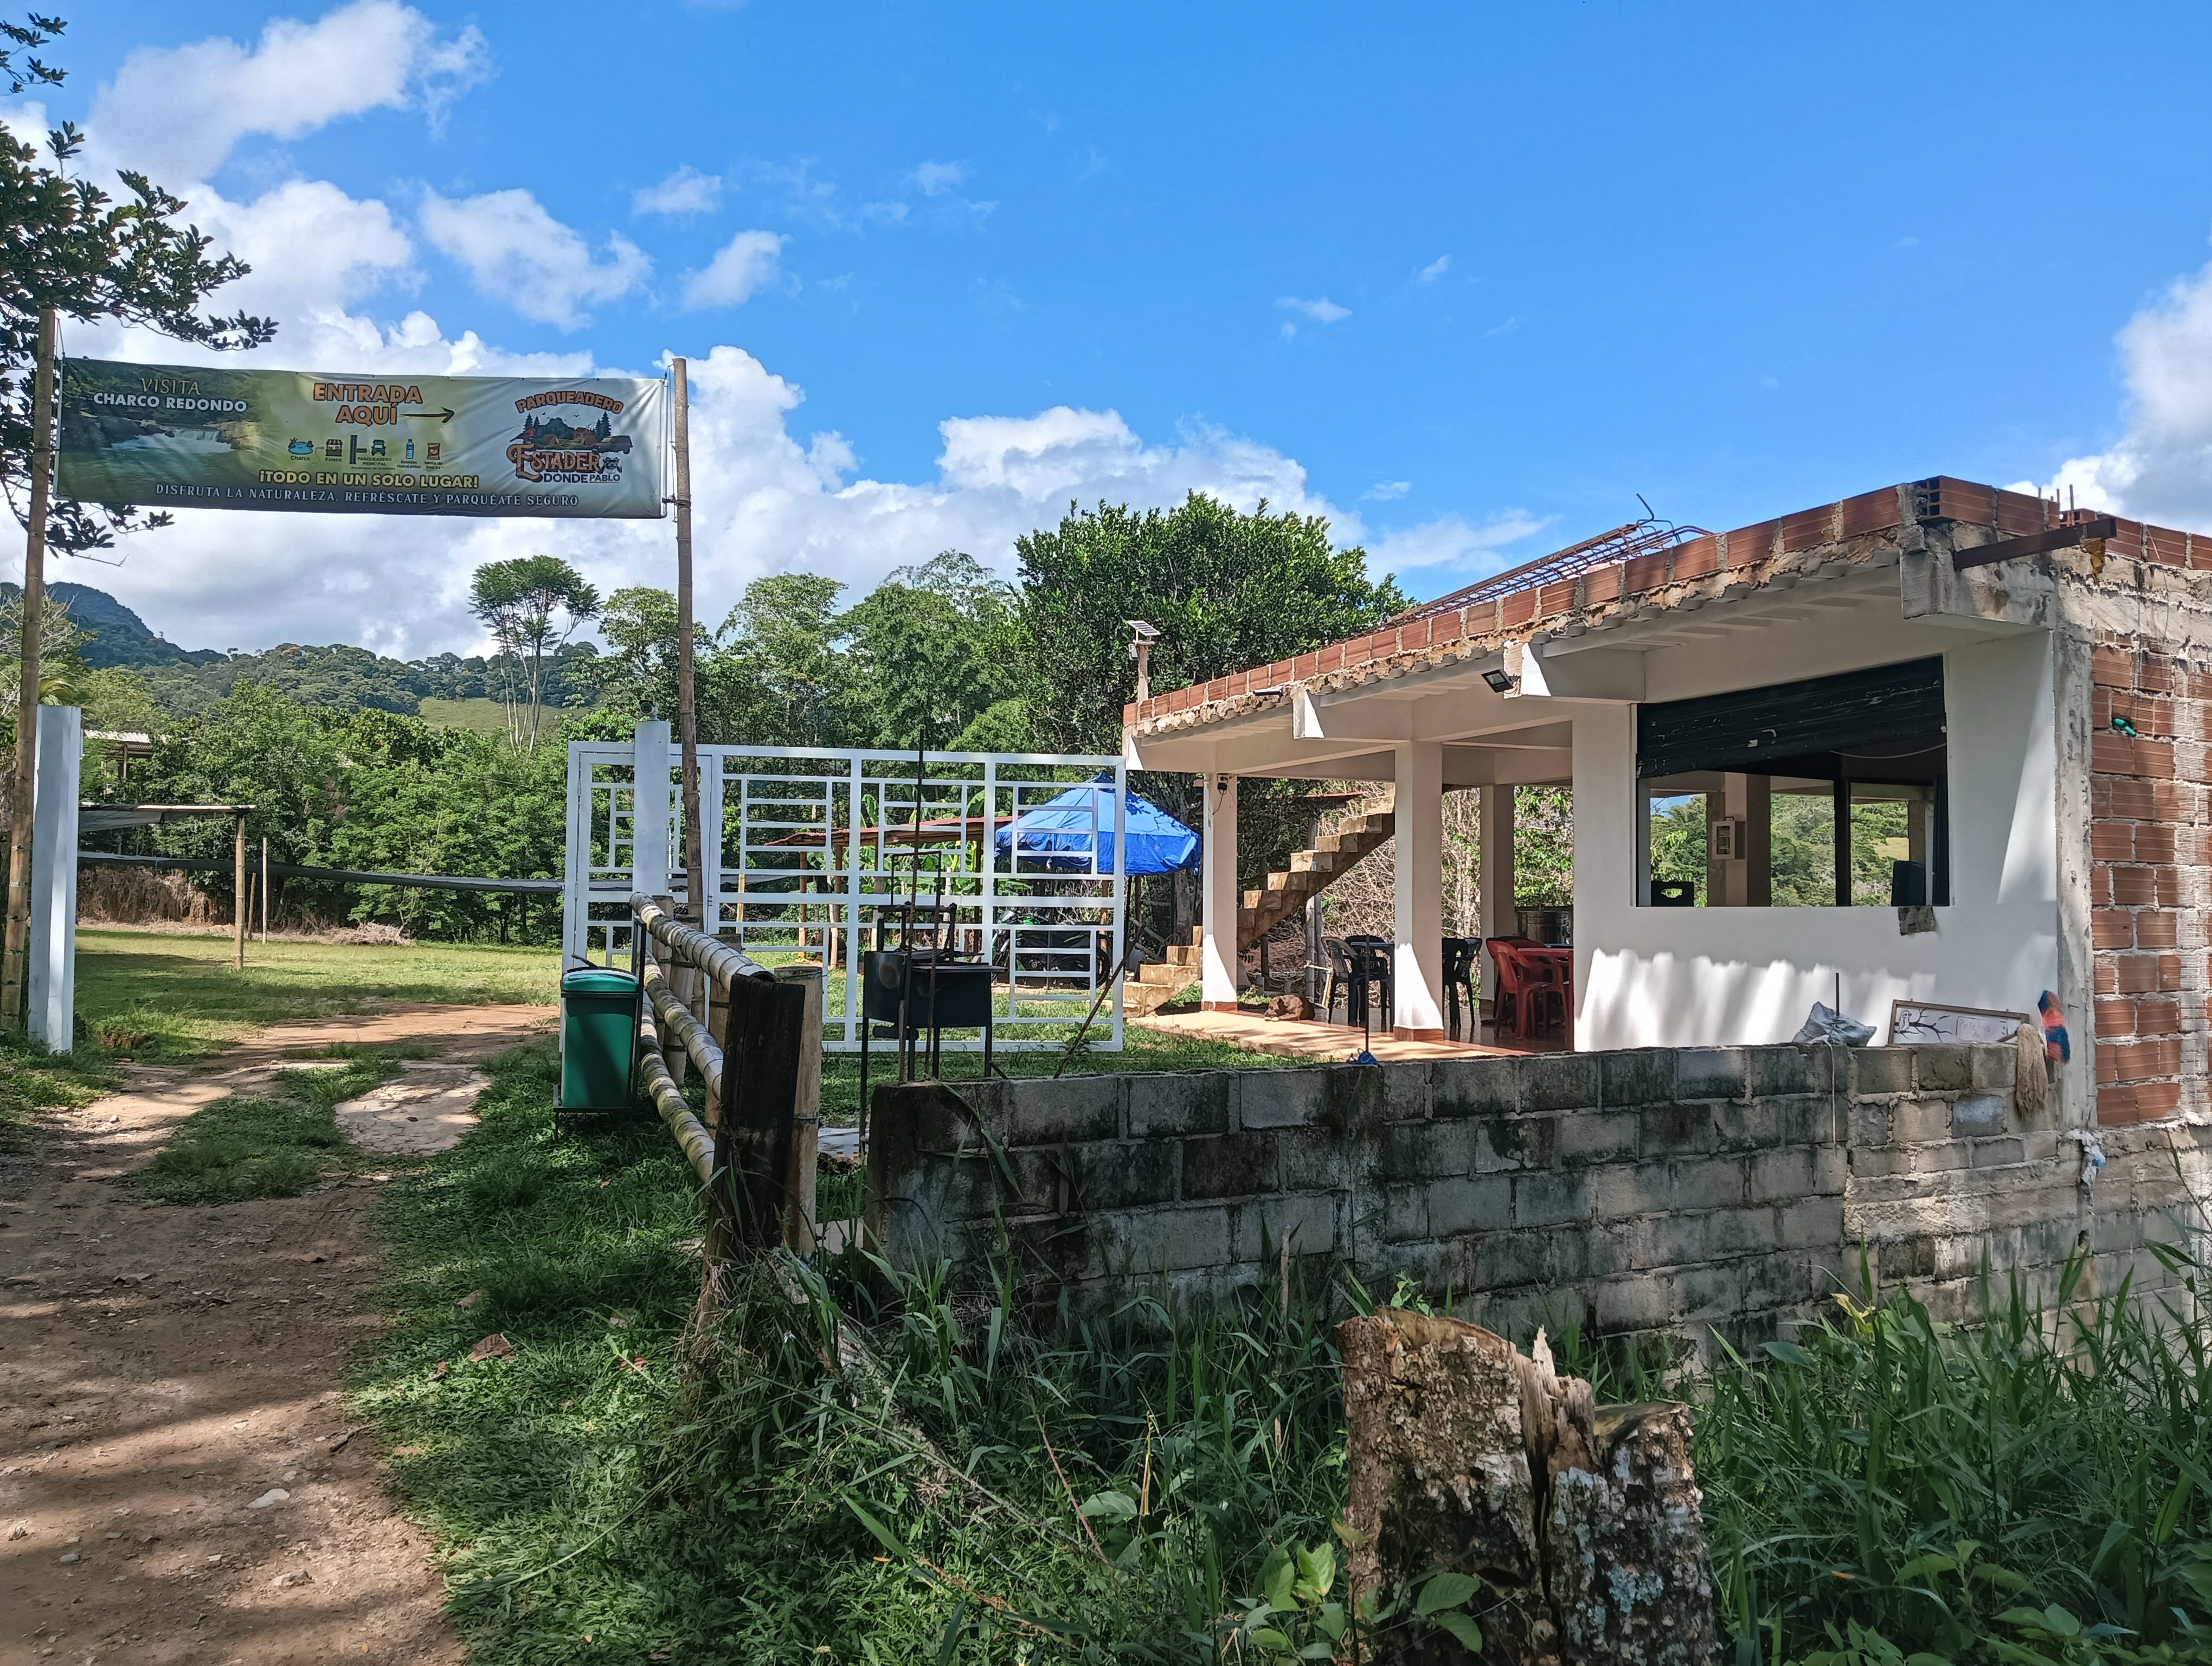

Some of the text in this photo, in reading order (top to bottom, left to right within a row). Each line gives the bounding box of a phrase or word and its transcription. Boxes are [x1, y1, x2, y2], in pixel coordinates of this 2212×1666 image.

[140, 377, 202, 395] VISITA
[313, 383, 423, 403] ENTRADA
[94, 393, 247, 412] CHARCO REDONDO
[515, 390, 624, 414] PARQUEADERO
[335, 402, 398, 427] AQUÍ
[316, 472, 338, 485] EN
[343, 473, 366, 486] UN
[371, 473, 415, 488] SOLO
[420, 475, 479, 489] LUGAR!
[544, 473, 588, 483] DONDE
[156, 484, 220, 498] DISFRUTA
[227, 489, 243, 498] LA
[345, 490, 427, 504] REFRÉSCATE
[433, 494, 441, 504] Y
[446, 491, 521, 506] PARQUÉATE
[526, 495, 579, 507] SEGURO
